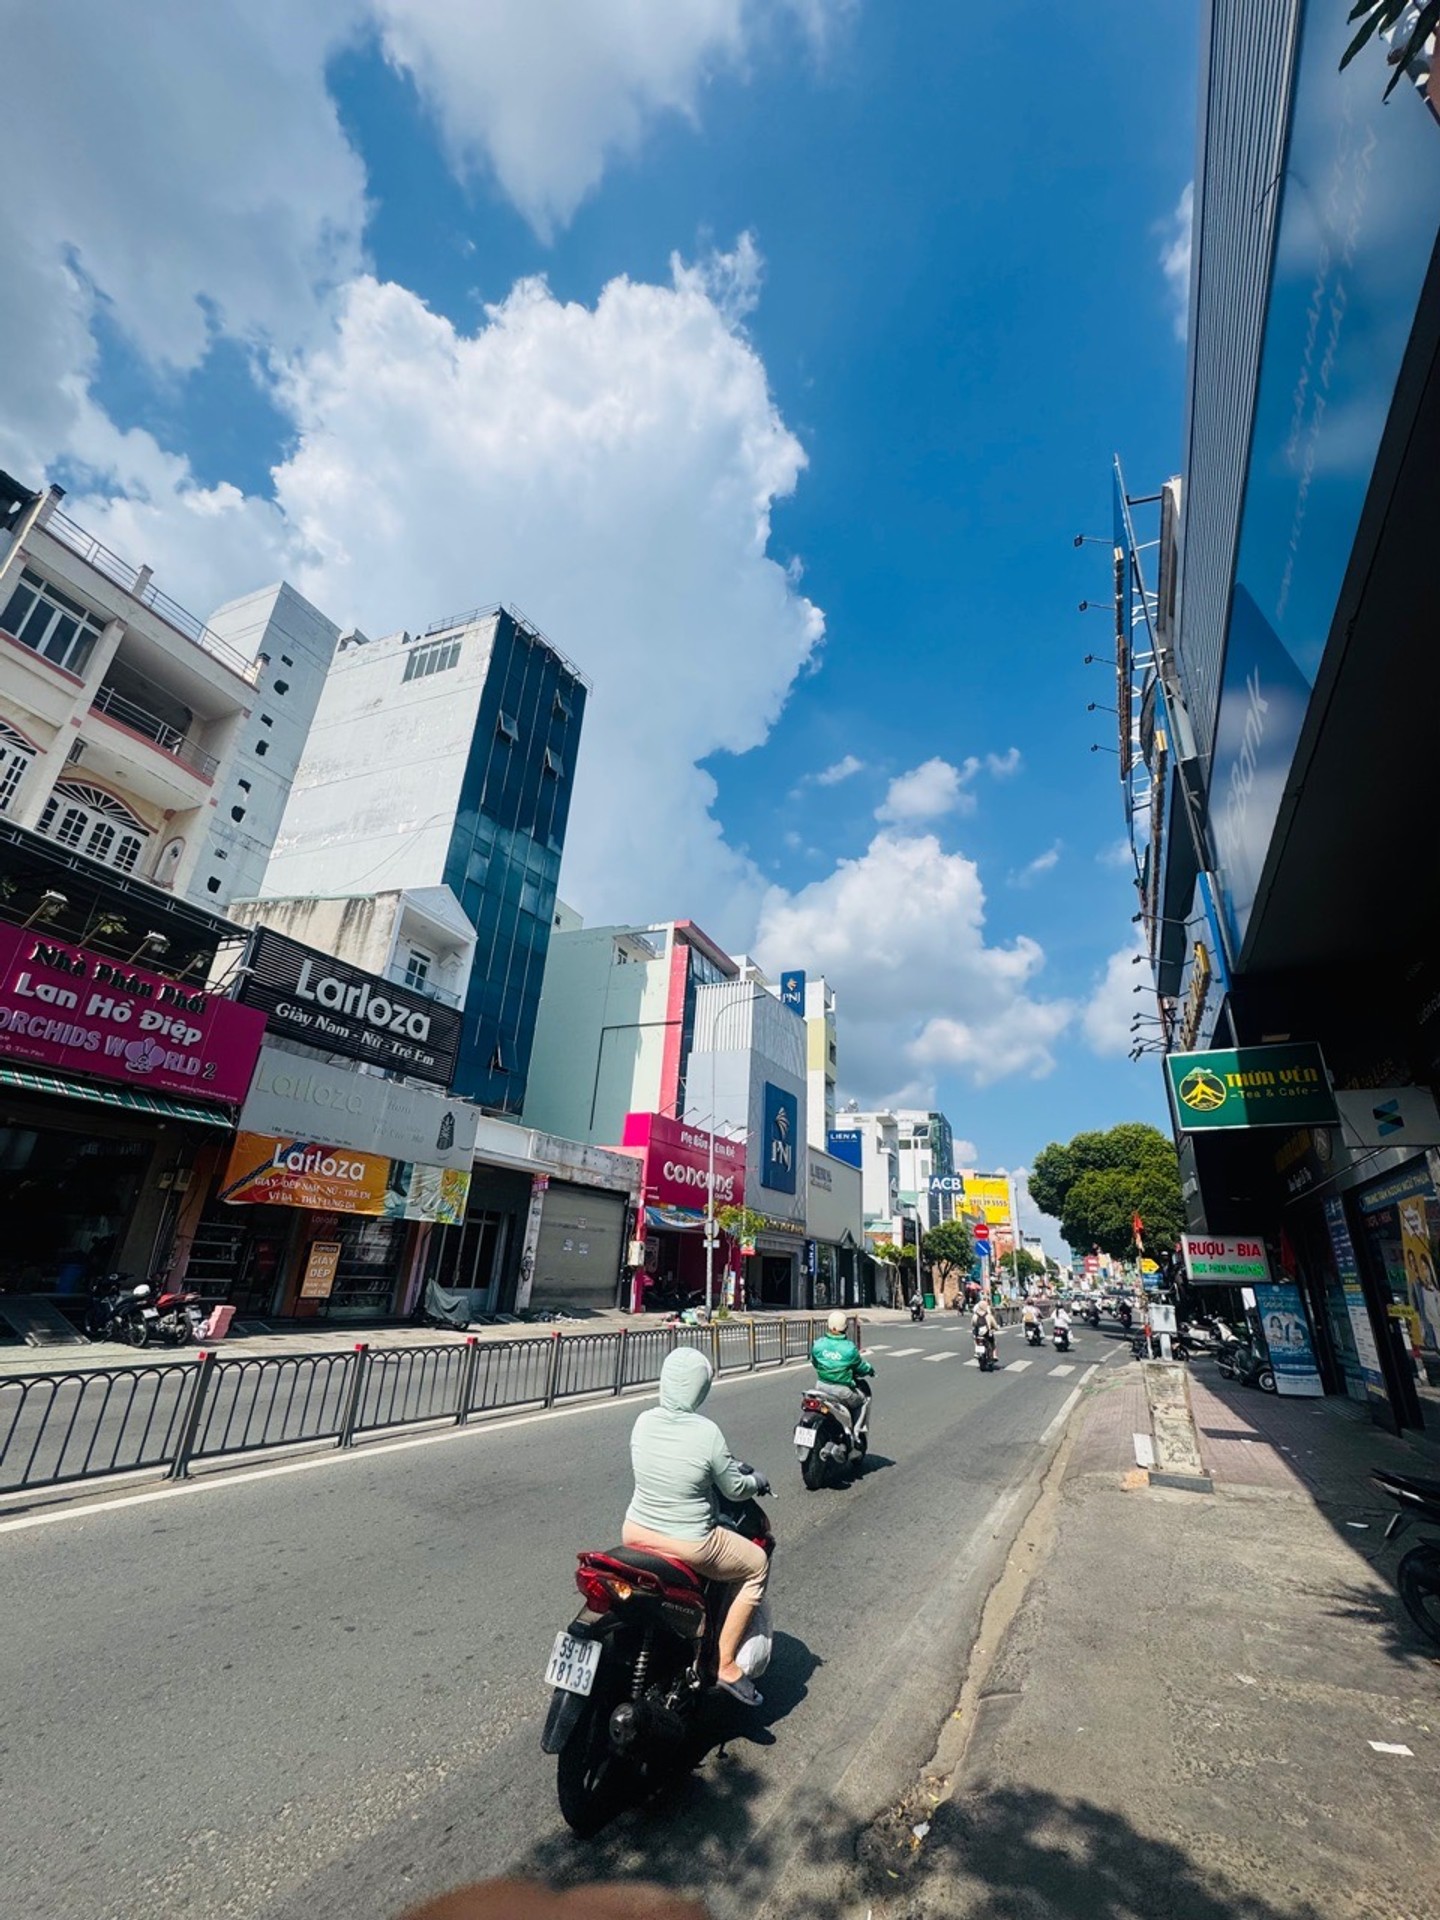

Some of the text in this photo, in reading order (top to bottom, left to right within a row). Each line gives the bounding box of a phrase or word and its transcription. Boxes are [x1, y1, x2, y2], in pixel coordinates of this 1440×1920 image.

[28, 941, 86, 976] Nhà
[93, 962, 153, 997] Phân
[14, 972, 202, 1047] Lan Hồ Điệp
[295, 958, 431, 1042] Larloza
[782, 991, 800, 1004] PNJ
[0, 1007, 102, 1051] ORCHIDS
[201, 1062, 217, 1080] 2
[275, 1002, 313, 1027] Giày
[314, 1015, 350, 1038] Nam
[414, 1049, 435, 1066] Em
[1238, 1090, 1261, 1099] Tea
[272, 1143, 366, 1181] Larloza
[771, 1140, 791, 1173] PNJ
[931, 1177, 961, 1191] ACB
[1188, 1241, 1225, 1260] RƯỢU
[1237, 1243, 1261, 1257] BIA
[550, 1659, 592, 1690] 181.33
